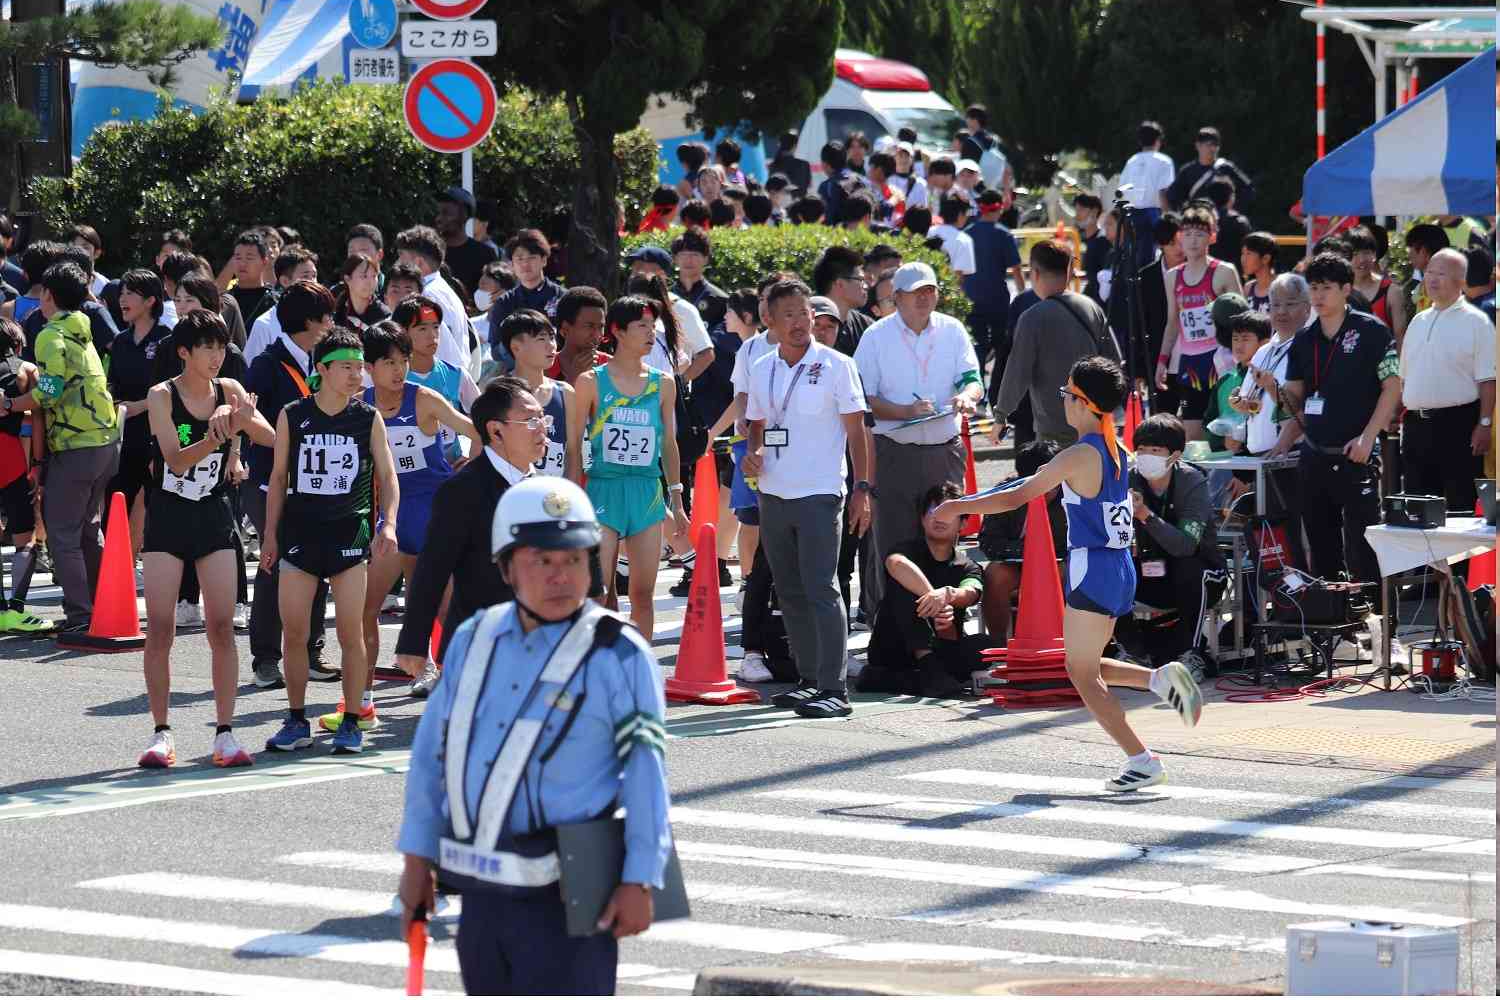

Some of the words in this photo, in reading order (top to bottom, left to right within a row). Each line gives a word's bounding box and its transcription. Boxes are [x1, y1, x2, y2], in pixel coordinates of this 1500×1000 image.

[207, 1, 257, 73] 横
[409, 29, 489, 48] ここから
[353, 56, 395, 78] 歩行者優先
[614, 408, 649, 424] IWATO
[394, 434, 416, 448] -2
[608, 427, 649, 454] 25-2
[302, 448, 354, 475] 11-2
[400, 456, 415, 469] 明
[311, 477, 348, 490] 田浦
